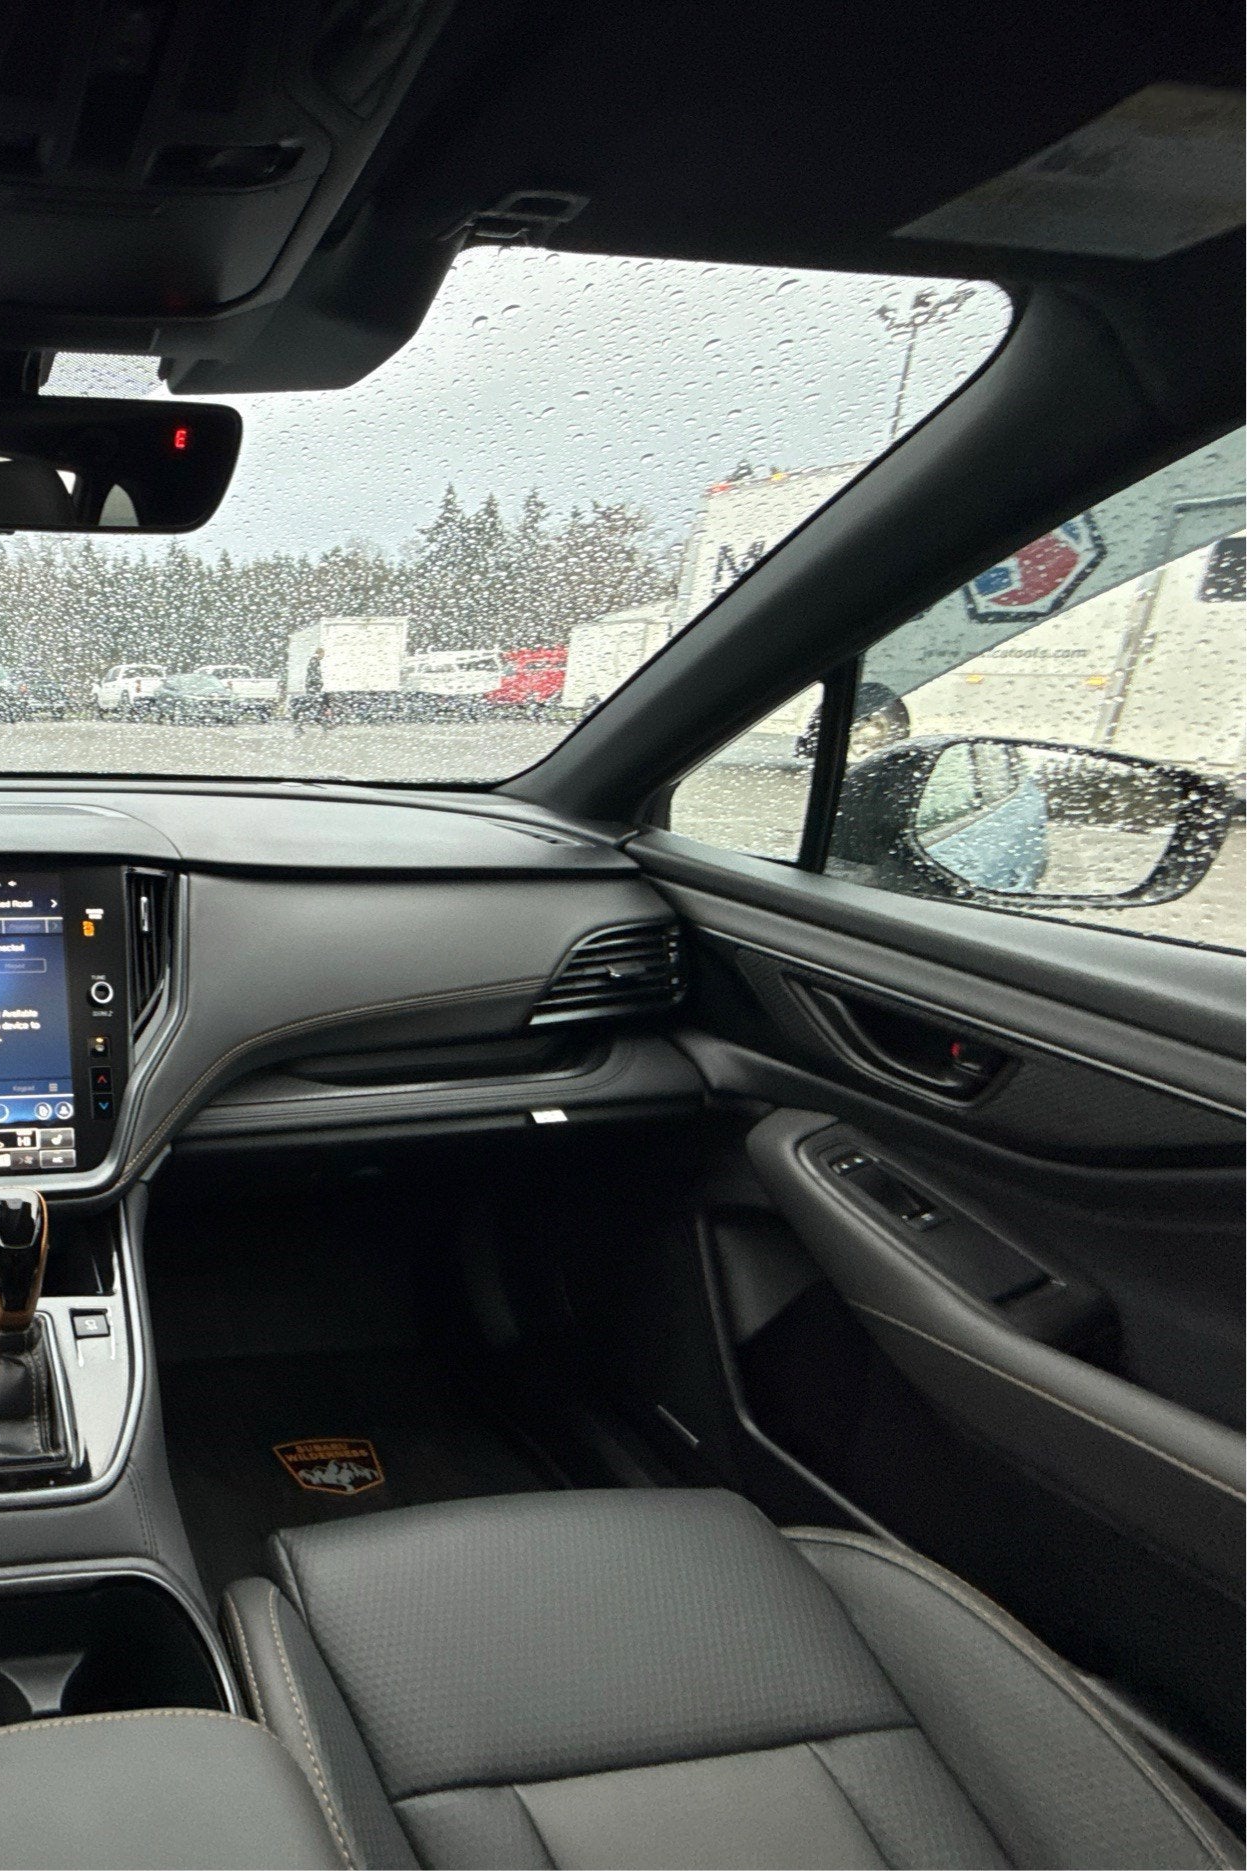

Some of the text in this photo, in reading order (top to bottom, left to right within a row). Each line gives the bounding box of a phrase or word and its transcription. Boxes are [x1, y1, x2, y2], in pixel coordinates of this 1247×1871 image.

[175, 430, 187, 448] E
[12, 900, 33, 908] Road
[2, 1009, 39, 1018] Available
[2, 1021, 29, 1030] device
[30, 1021, 41, 1030] to
